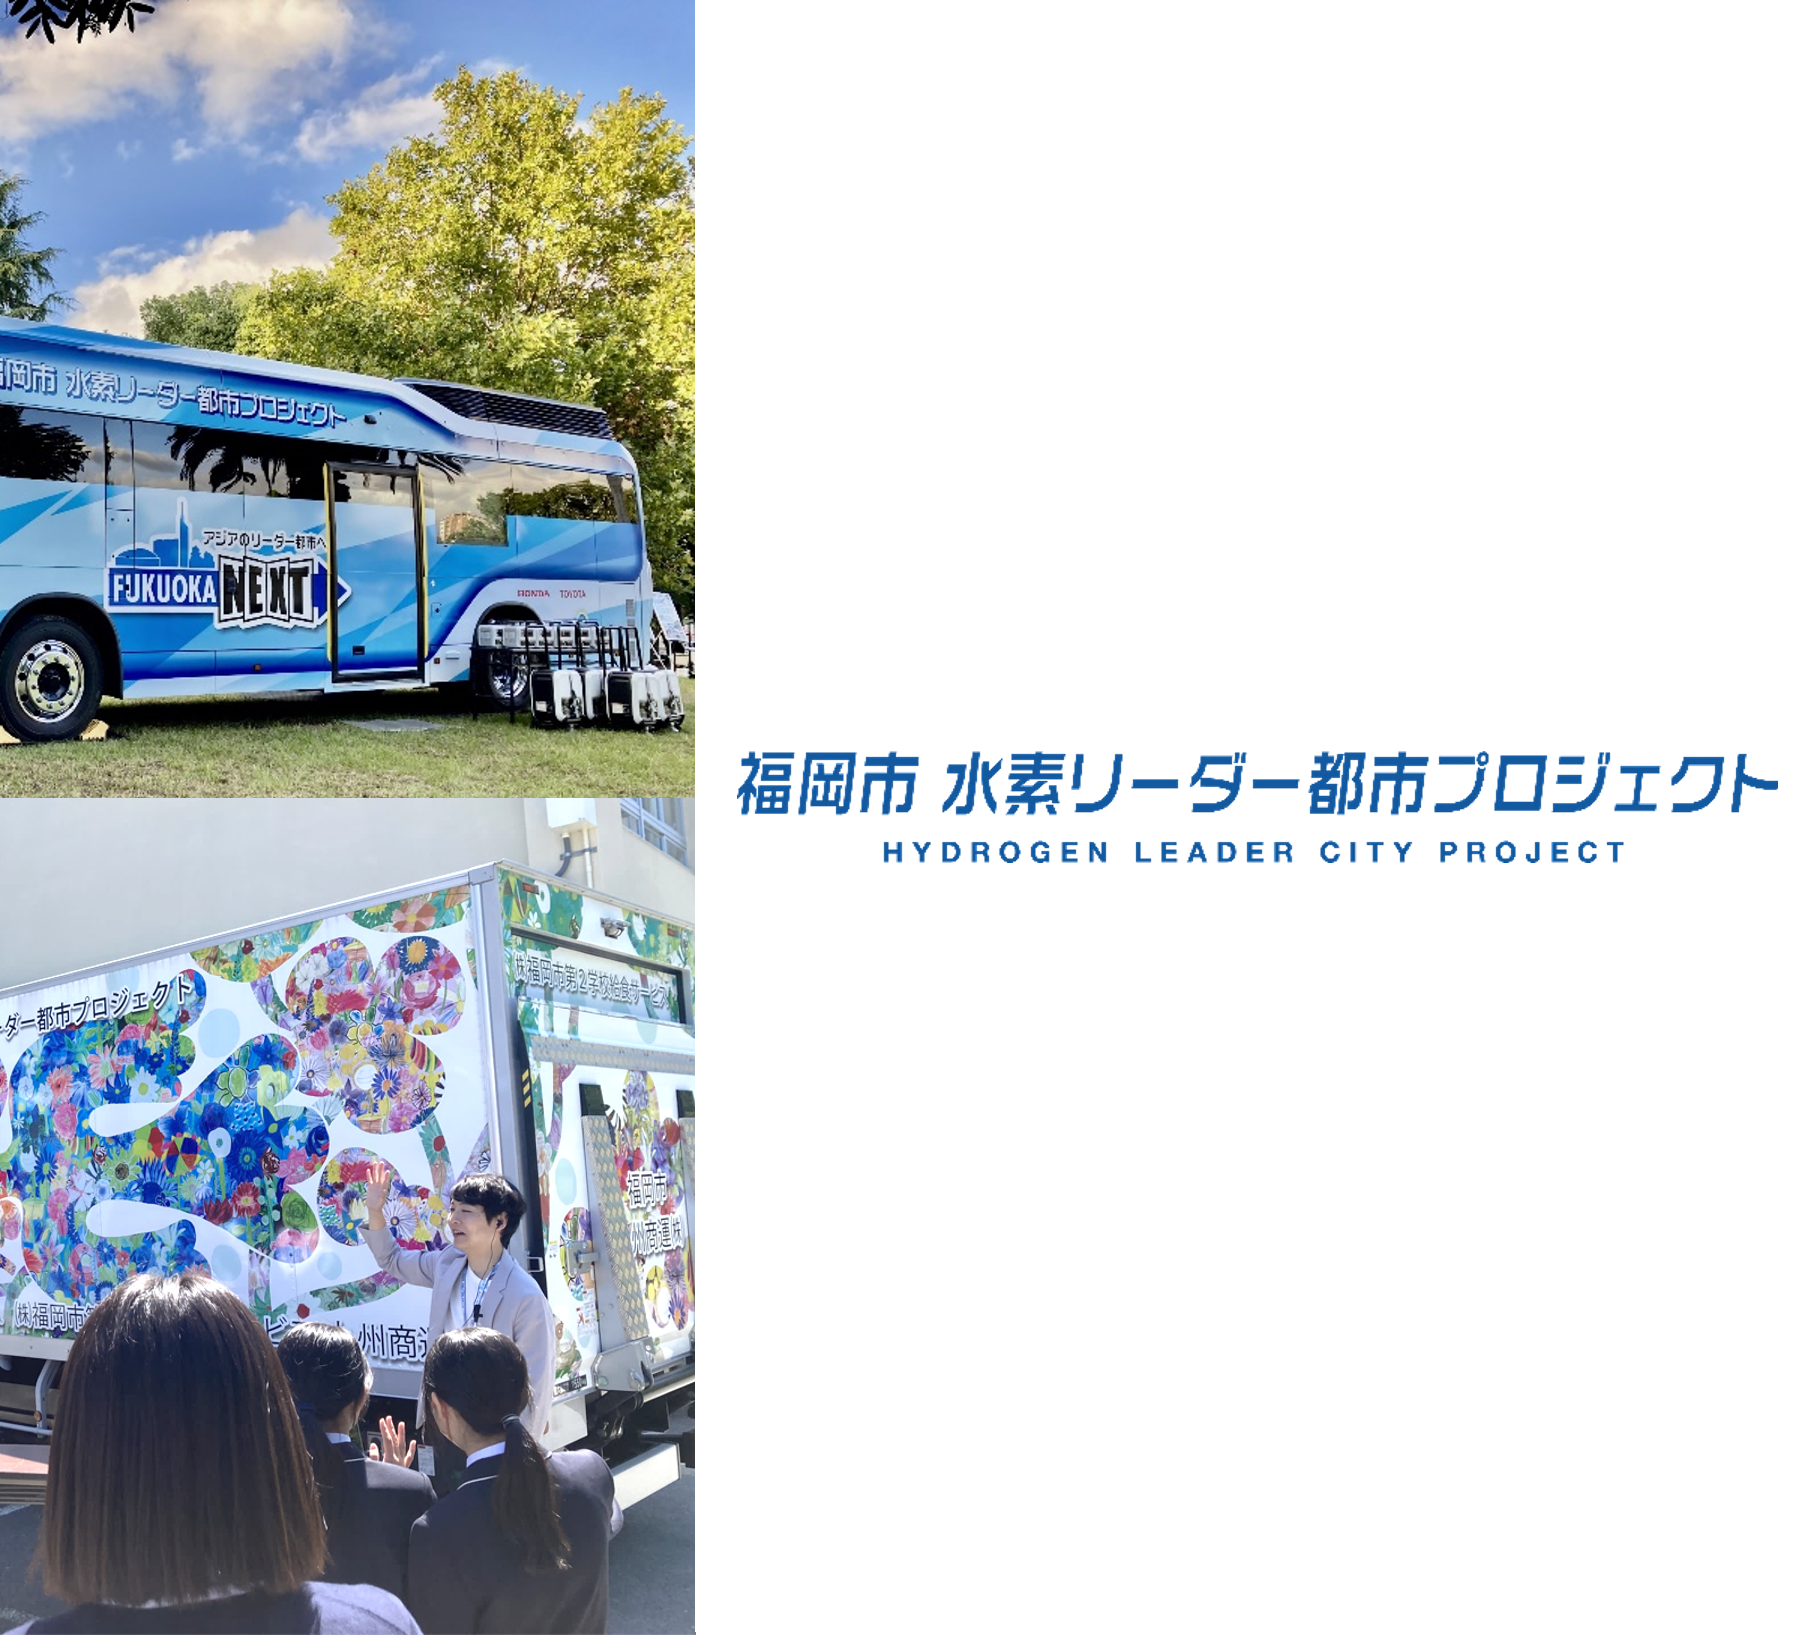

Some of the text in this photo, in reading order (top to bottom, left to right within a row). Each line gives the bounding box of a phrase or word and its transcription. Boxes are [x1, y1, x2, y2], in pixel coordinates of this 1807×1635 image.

[66, 368, 346, 428] 水素リーダー都市プロジェクト
[203, 531, 327, 549] アジアのリーダー都市へ
[113, 562, 310, 616] FUKUOKA NEXT
[517, 589, 586, 598] HONDA TOYOTA
[628, 1170, 666, 1205] 福岡市
